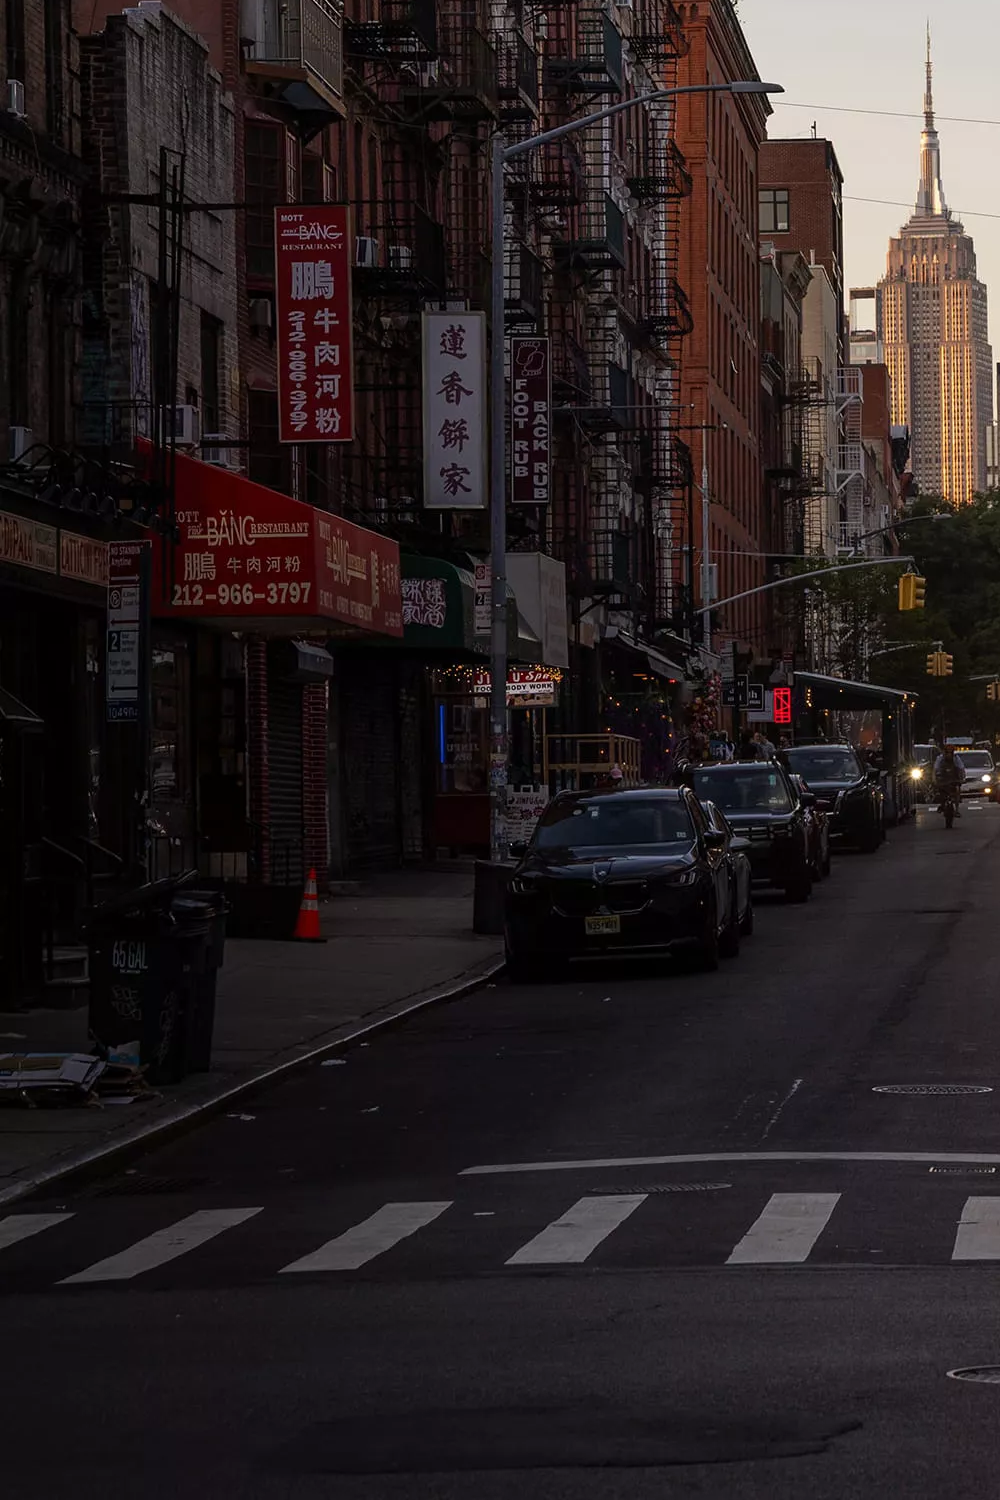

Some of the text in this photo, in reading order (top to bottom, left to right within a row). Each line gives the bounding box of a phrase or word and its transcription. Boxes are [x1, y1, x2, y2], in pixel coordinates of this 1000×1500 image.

[281, 214, 304, 222] MOTT
[282, 243, 343, 251] RESTAURANT
[290, 260, 334, 300] 鵬
[313, 307, 341, 433] 牛肉河粉
[437, 324, 473, 496] 蓮香餅家
[514, 379, 529, 477] FOOT RUB
[532, 400, 548, 499] BACK RUB
[174, 511, 199, 523] OTT
[251, 522, 309, 534] RESTAURANT
[184, 551, 300, 581] 鵬 牛肉河粉
[171, 582, 311, 606] 212-966-3797
[111, 632, 118, 650] 2
[112, 940, 148, 970] 65 GAL
